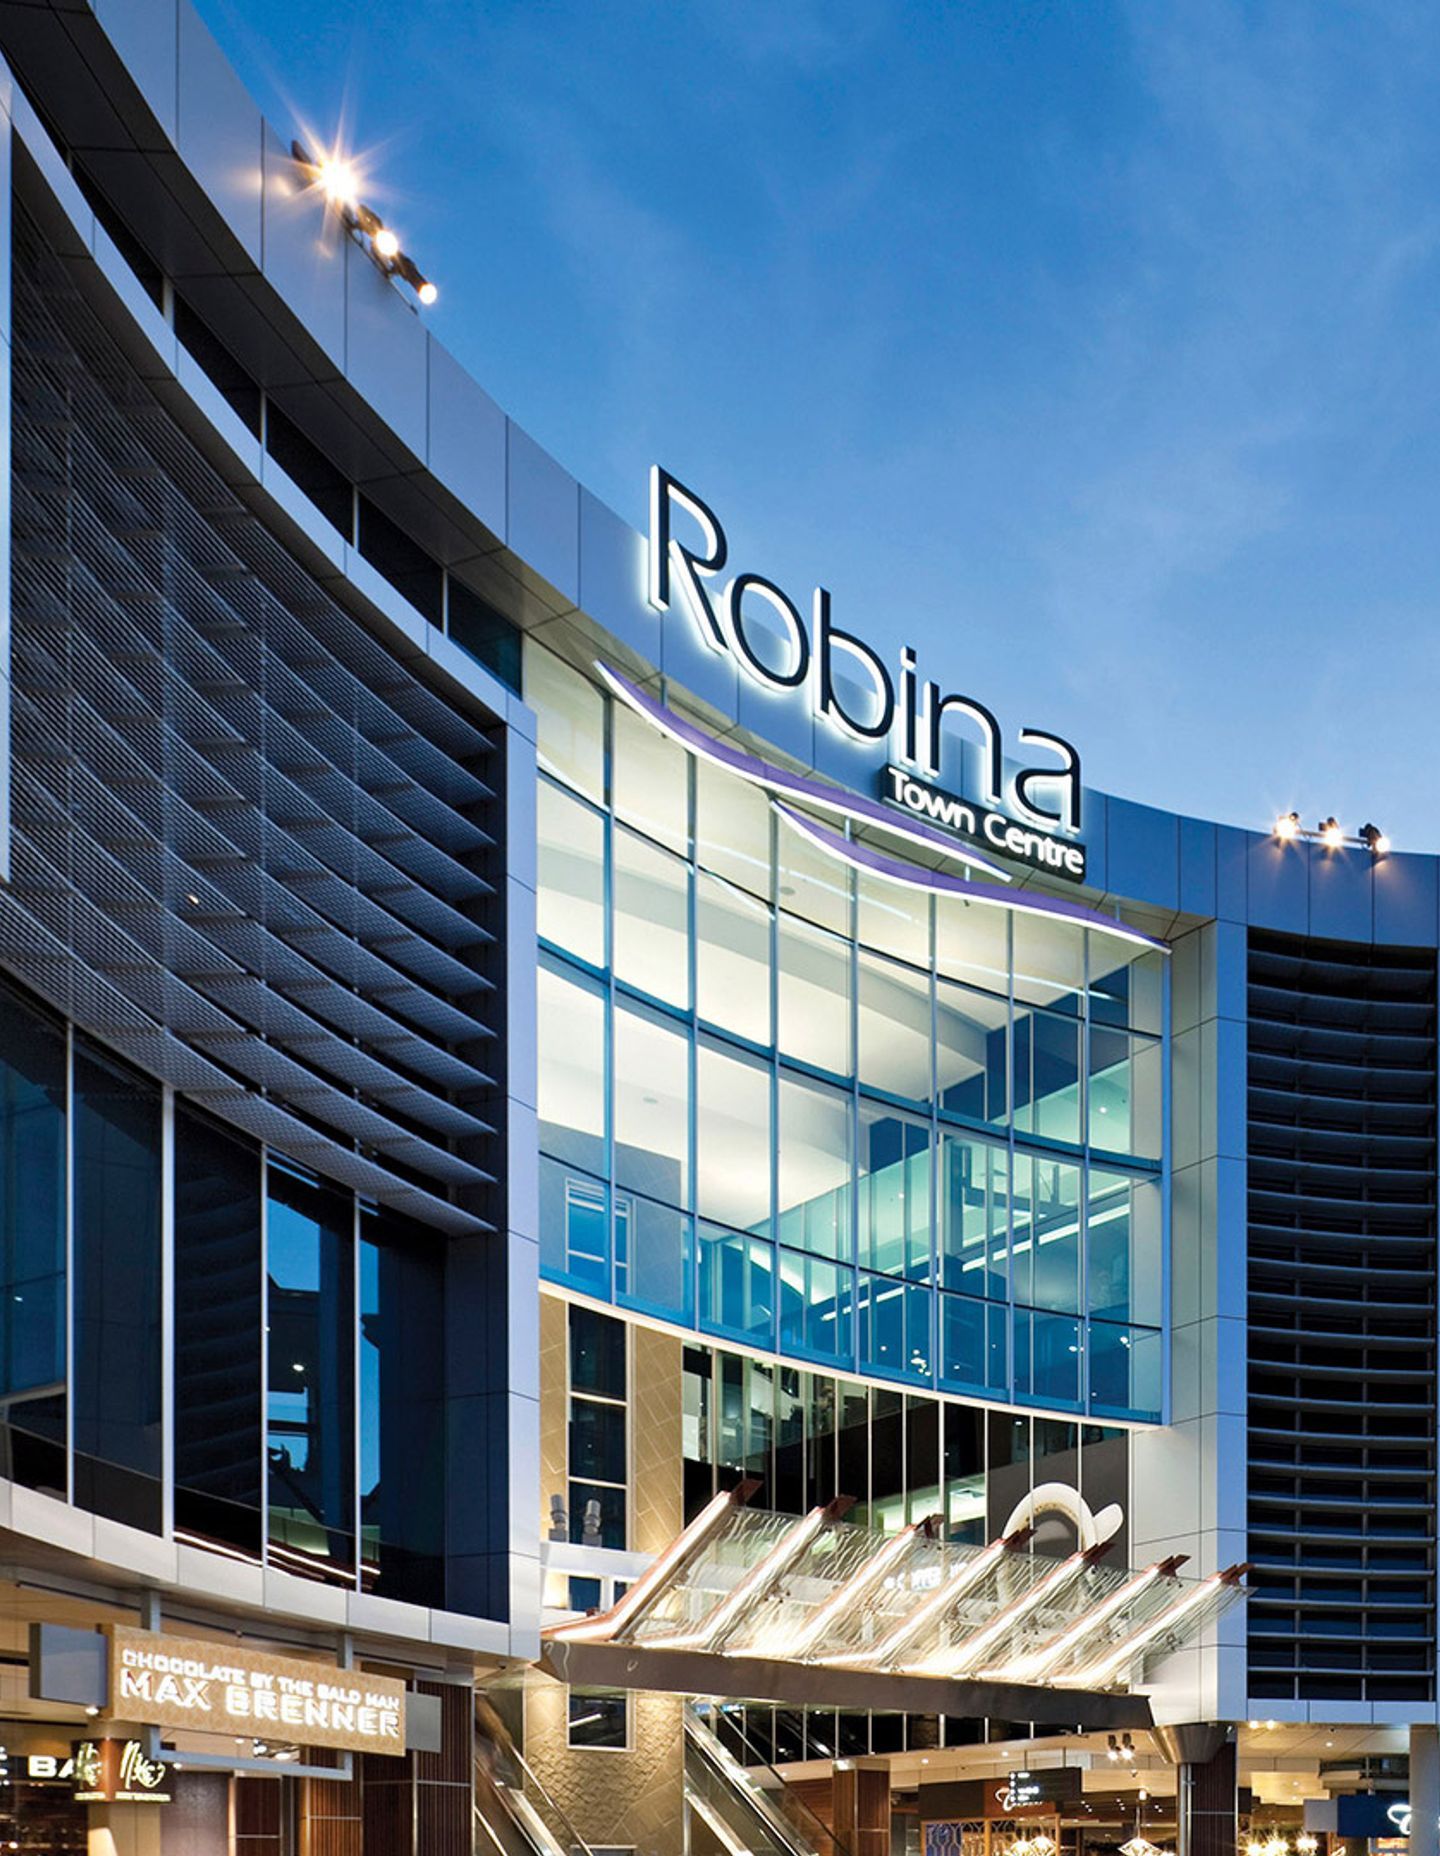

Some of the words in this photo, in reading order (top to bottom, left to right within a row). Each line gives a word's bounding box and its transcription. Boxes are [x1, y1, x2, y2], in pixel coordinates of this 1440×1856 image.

[649, 464, 1082, 836] Robina
[888, 767, 975, 835] Town
[984, 813, 1085, 875] Centre
[120, 1667, 212, 1712] MAX
[225, 1685, 399, 1738] BRENNER
[122, 1648, 246, 1685] CHOCOLATE
[250, 1672, 275, 1689] BY
[277, 1676, 314, 1698] THE
[317, 1684, 361, 1705] BALD
[365, 1692, 400, 1711] MAN
